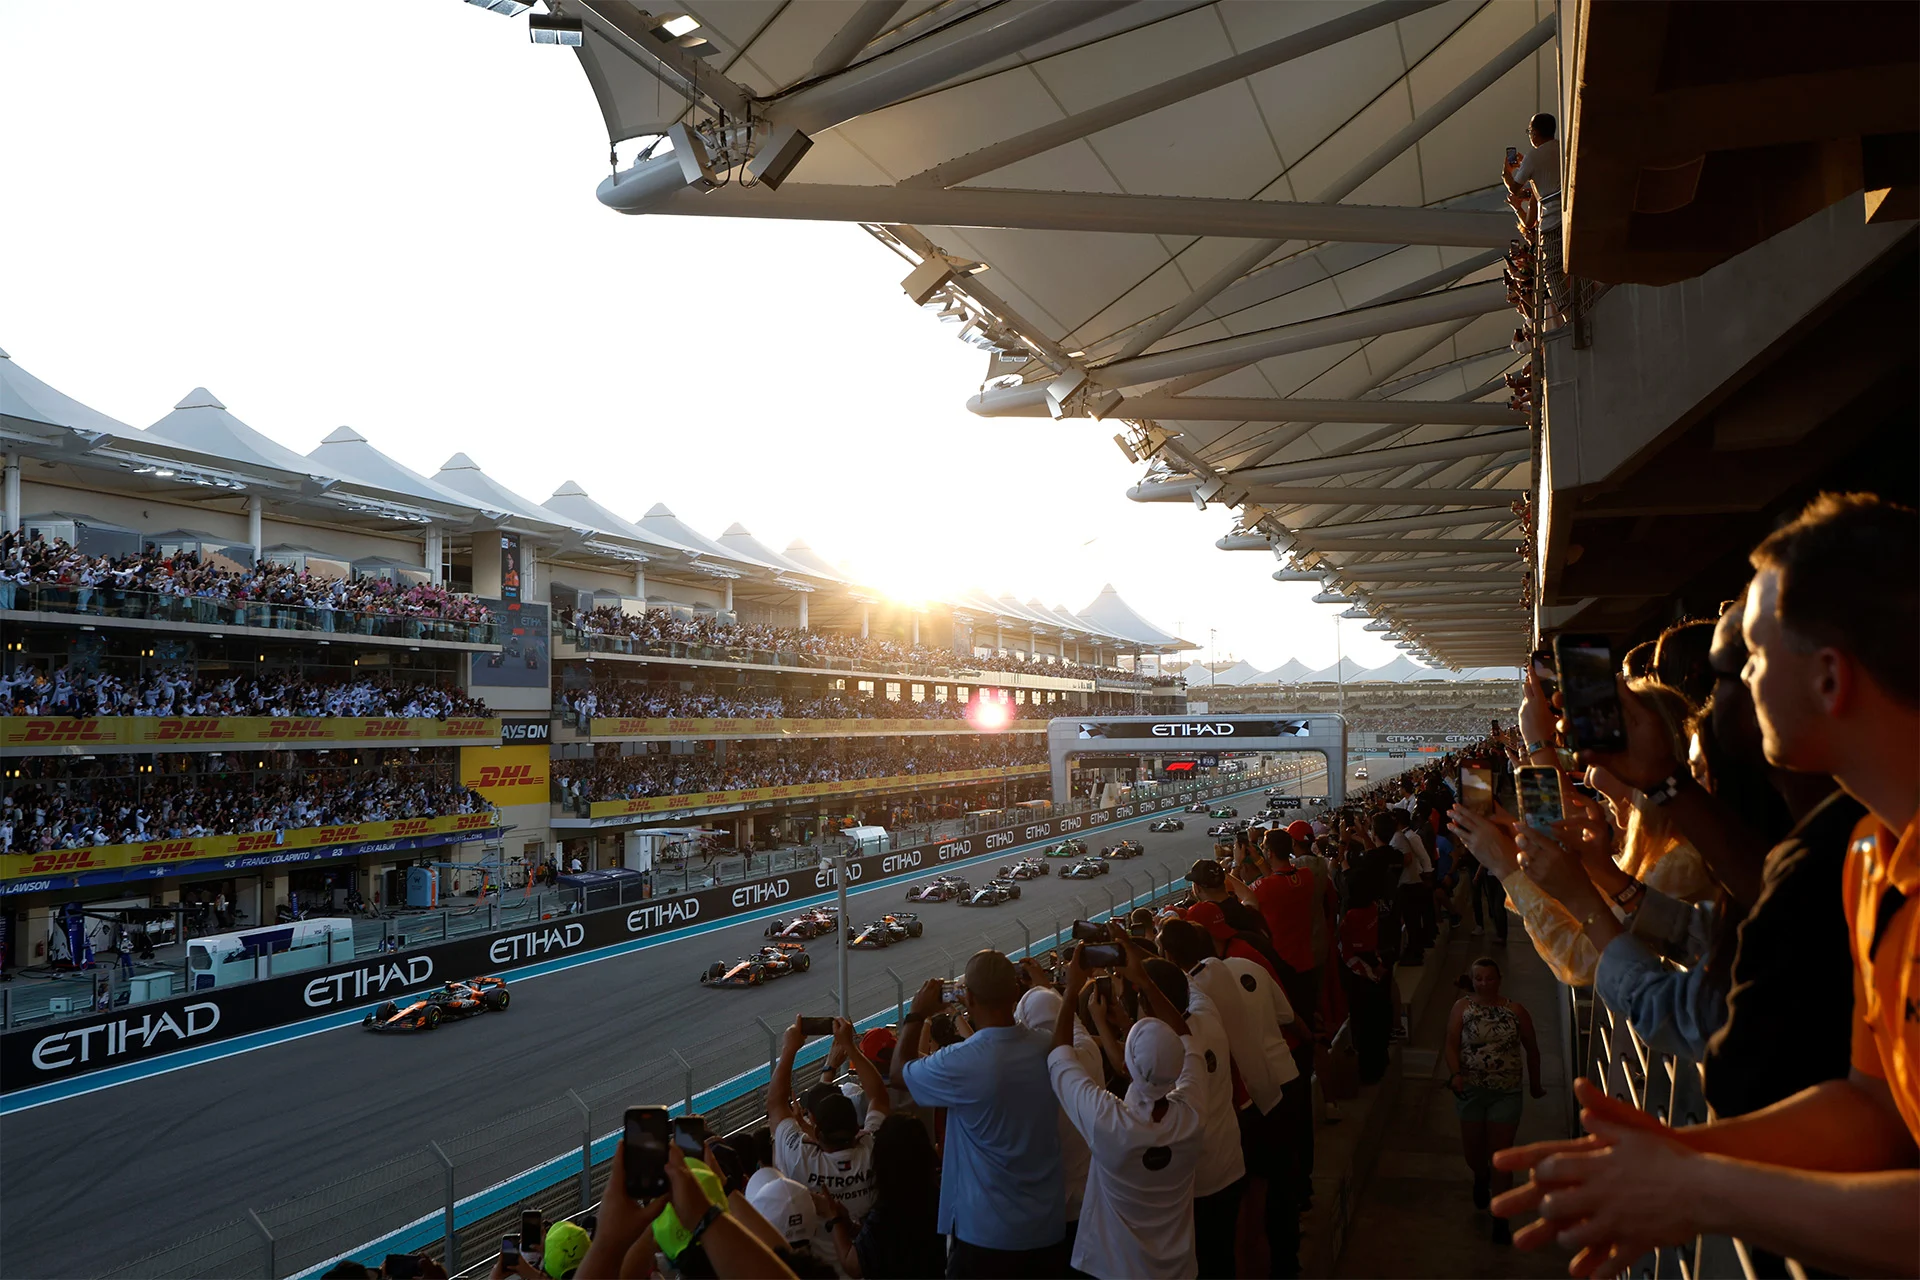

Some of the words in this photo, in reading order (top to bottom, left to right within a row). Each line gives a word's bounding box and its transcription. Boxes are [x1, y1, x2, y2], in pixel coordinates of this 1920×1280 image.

[24, 721, 101, 741] DHL
[157, 720, 222, 739] DHL
[269, 720, 325, 738] DHL
[364, 720, 412, 737] DHL
[444, 720, 487, 736] DHL
[619, 720, 648, 733] DHL
[669, 720, 694, 732] DHL
[713, 720, 737, 732] DHL
[1152, 723, 1234, 736] ETIHAD
[1202, 757, 1215, 766] FIA
[480, 765, 534, 787] DHL
[669, 797, 691, 809] DHL
[707, 793, 726, 804] DHL
[741, 790, 758, 801] DHL
[1273, 799, 1299, 807] ETIHAD
[628, 801, 653, 813] DHL
[1116, 805, 1134, 819] ETIHAD
[456, 814, 490, 830] DHL
[1060, 816, 1082, 832] ETIHAD
[1090, 810, 1109, 825] ETIHAD
[319, 827, 361, 844] DHL
[392, 819, 429, 836] DHL
[1025, 822, 1051, 841] ETIHAD
[236, 833, 285, 852] DHL
[986, 830, 1014, 849] ETIHAD
[141, 842, 196, 862] DHL
[271, 852, 310, 863] COLAPINTO
[332, 848, 343, 857] 23
[358, 845, 375, 853] ALEX
[938, 839, 971, 861] ETIHAD
[31, 852, 95, 872] DHL
[882, 850, 922, 874] ETIHAD
[815, 863, 863, 889] ETIAD
[6, 880, 50, 894] LAWSON
[732, 879, 789, 907] ETIHAD
[627, 899, 699, 932] ETIHAD
[490, 923, 584, 964] ETIHAD
[304, 955, 433, 1007] ETIHAD
[32, 1002, 220, 1070] ETIHAD
[808, 1170, 873, 1187] PETRONA
